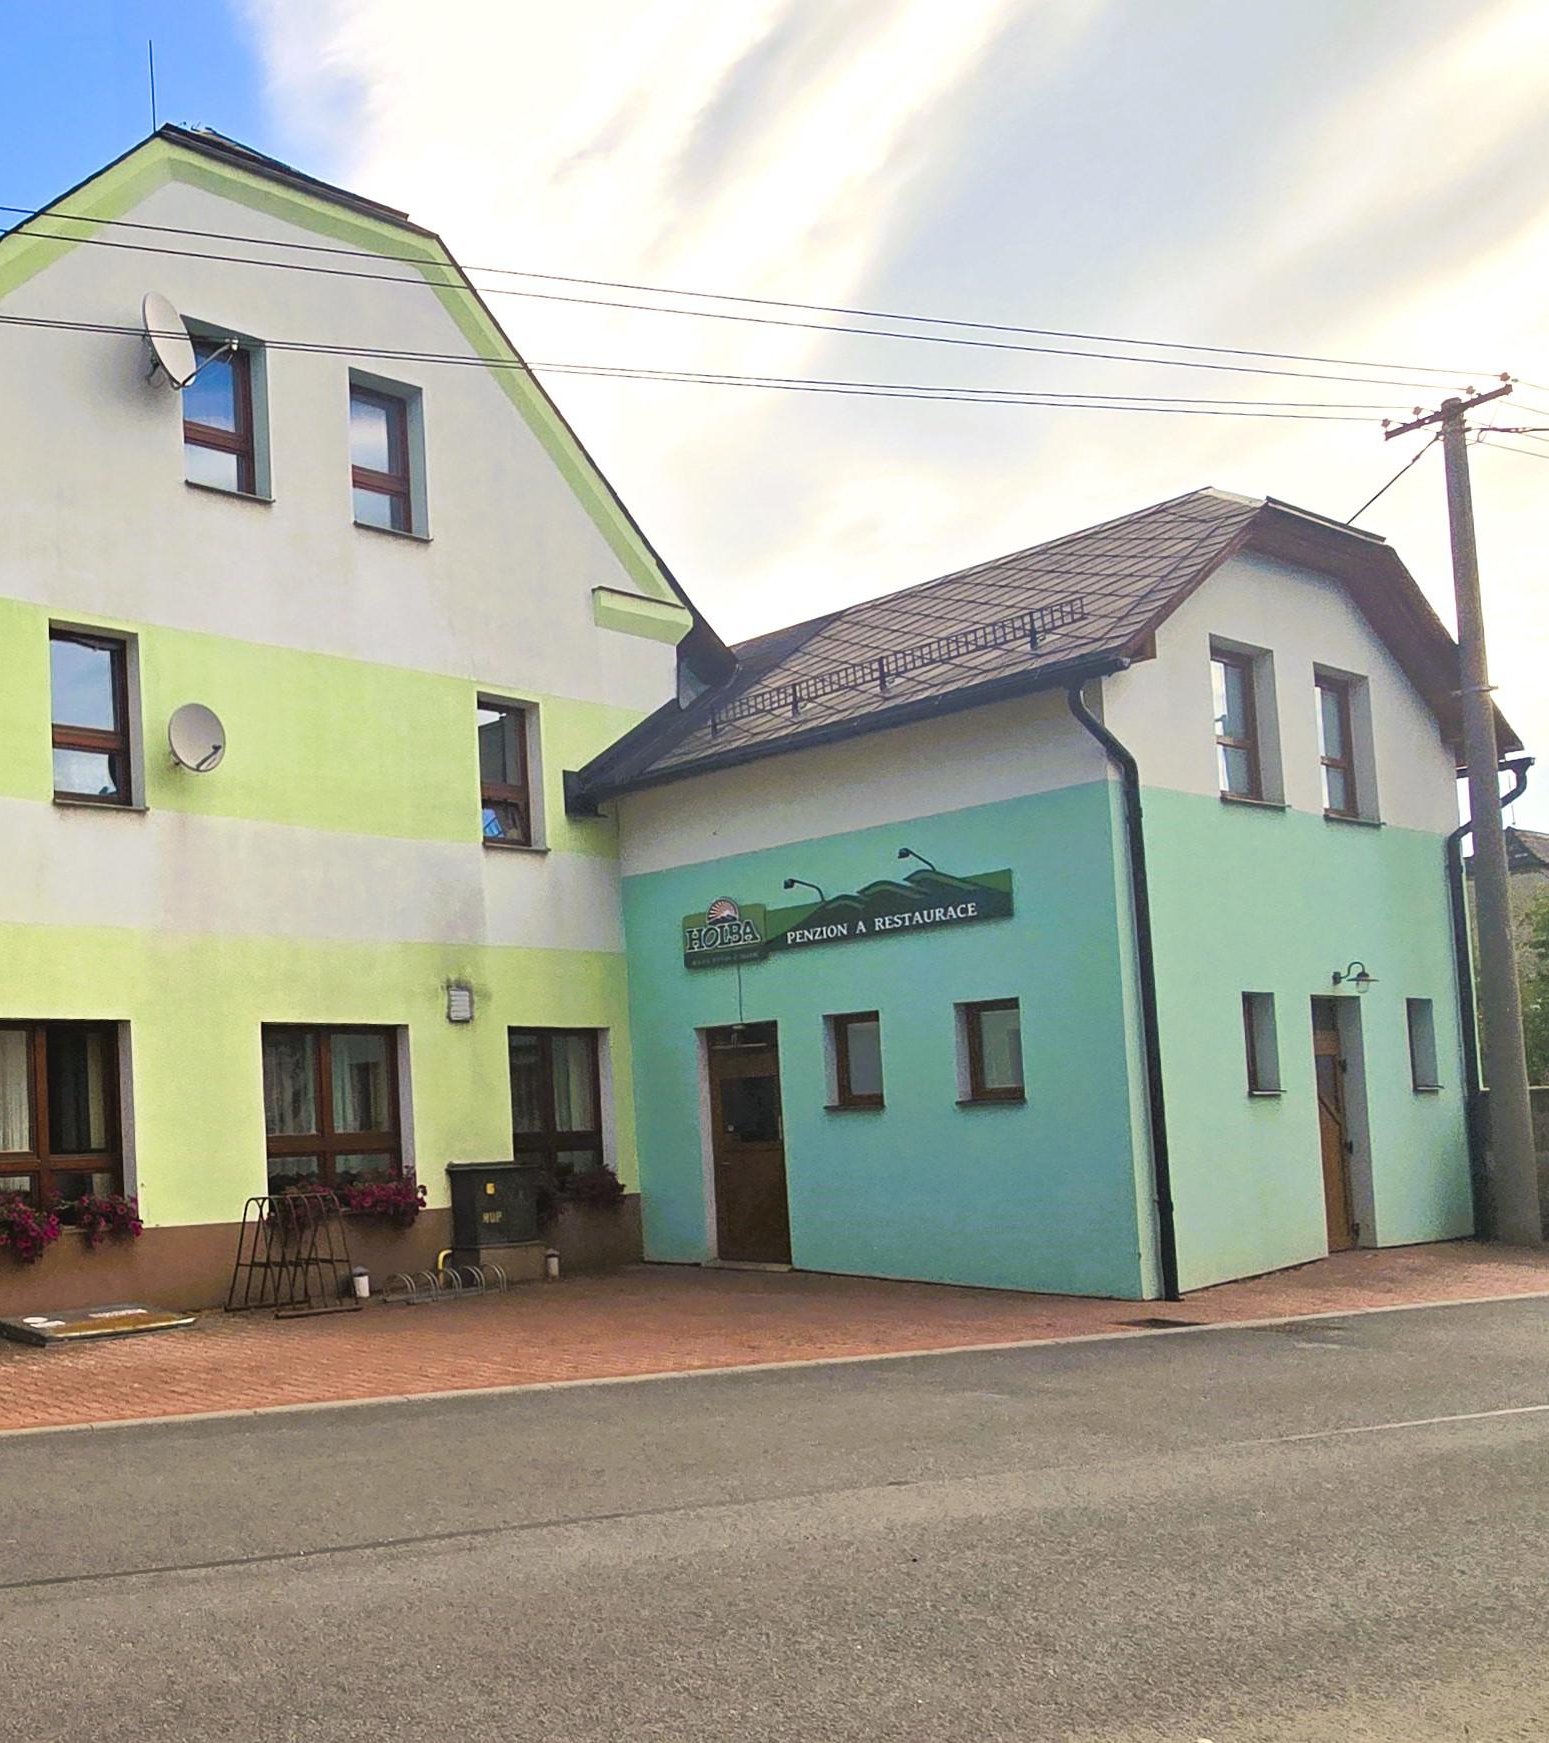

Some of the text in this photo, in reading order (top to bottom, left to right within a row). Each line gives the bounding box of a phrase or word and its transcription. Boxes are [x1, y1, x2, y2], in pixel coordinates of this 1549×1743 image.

[686, 920, 761, 952] HOLBA
[786, 902, 978, 944] PENZION A RESTAURACE
